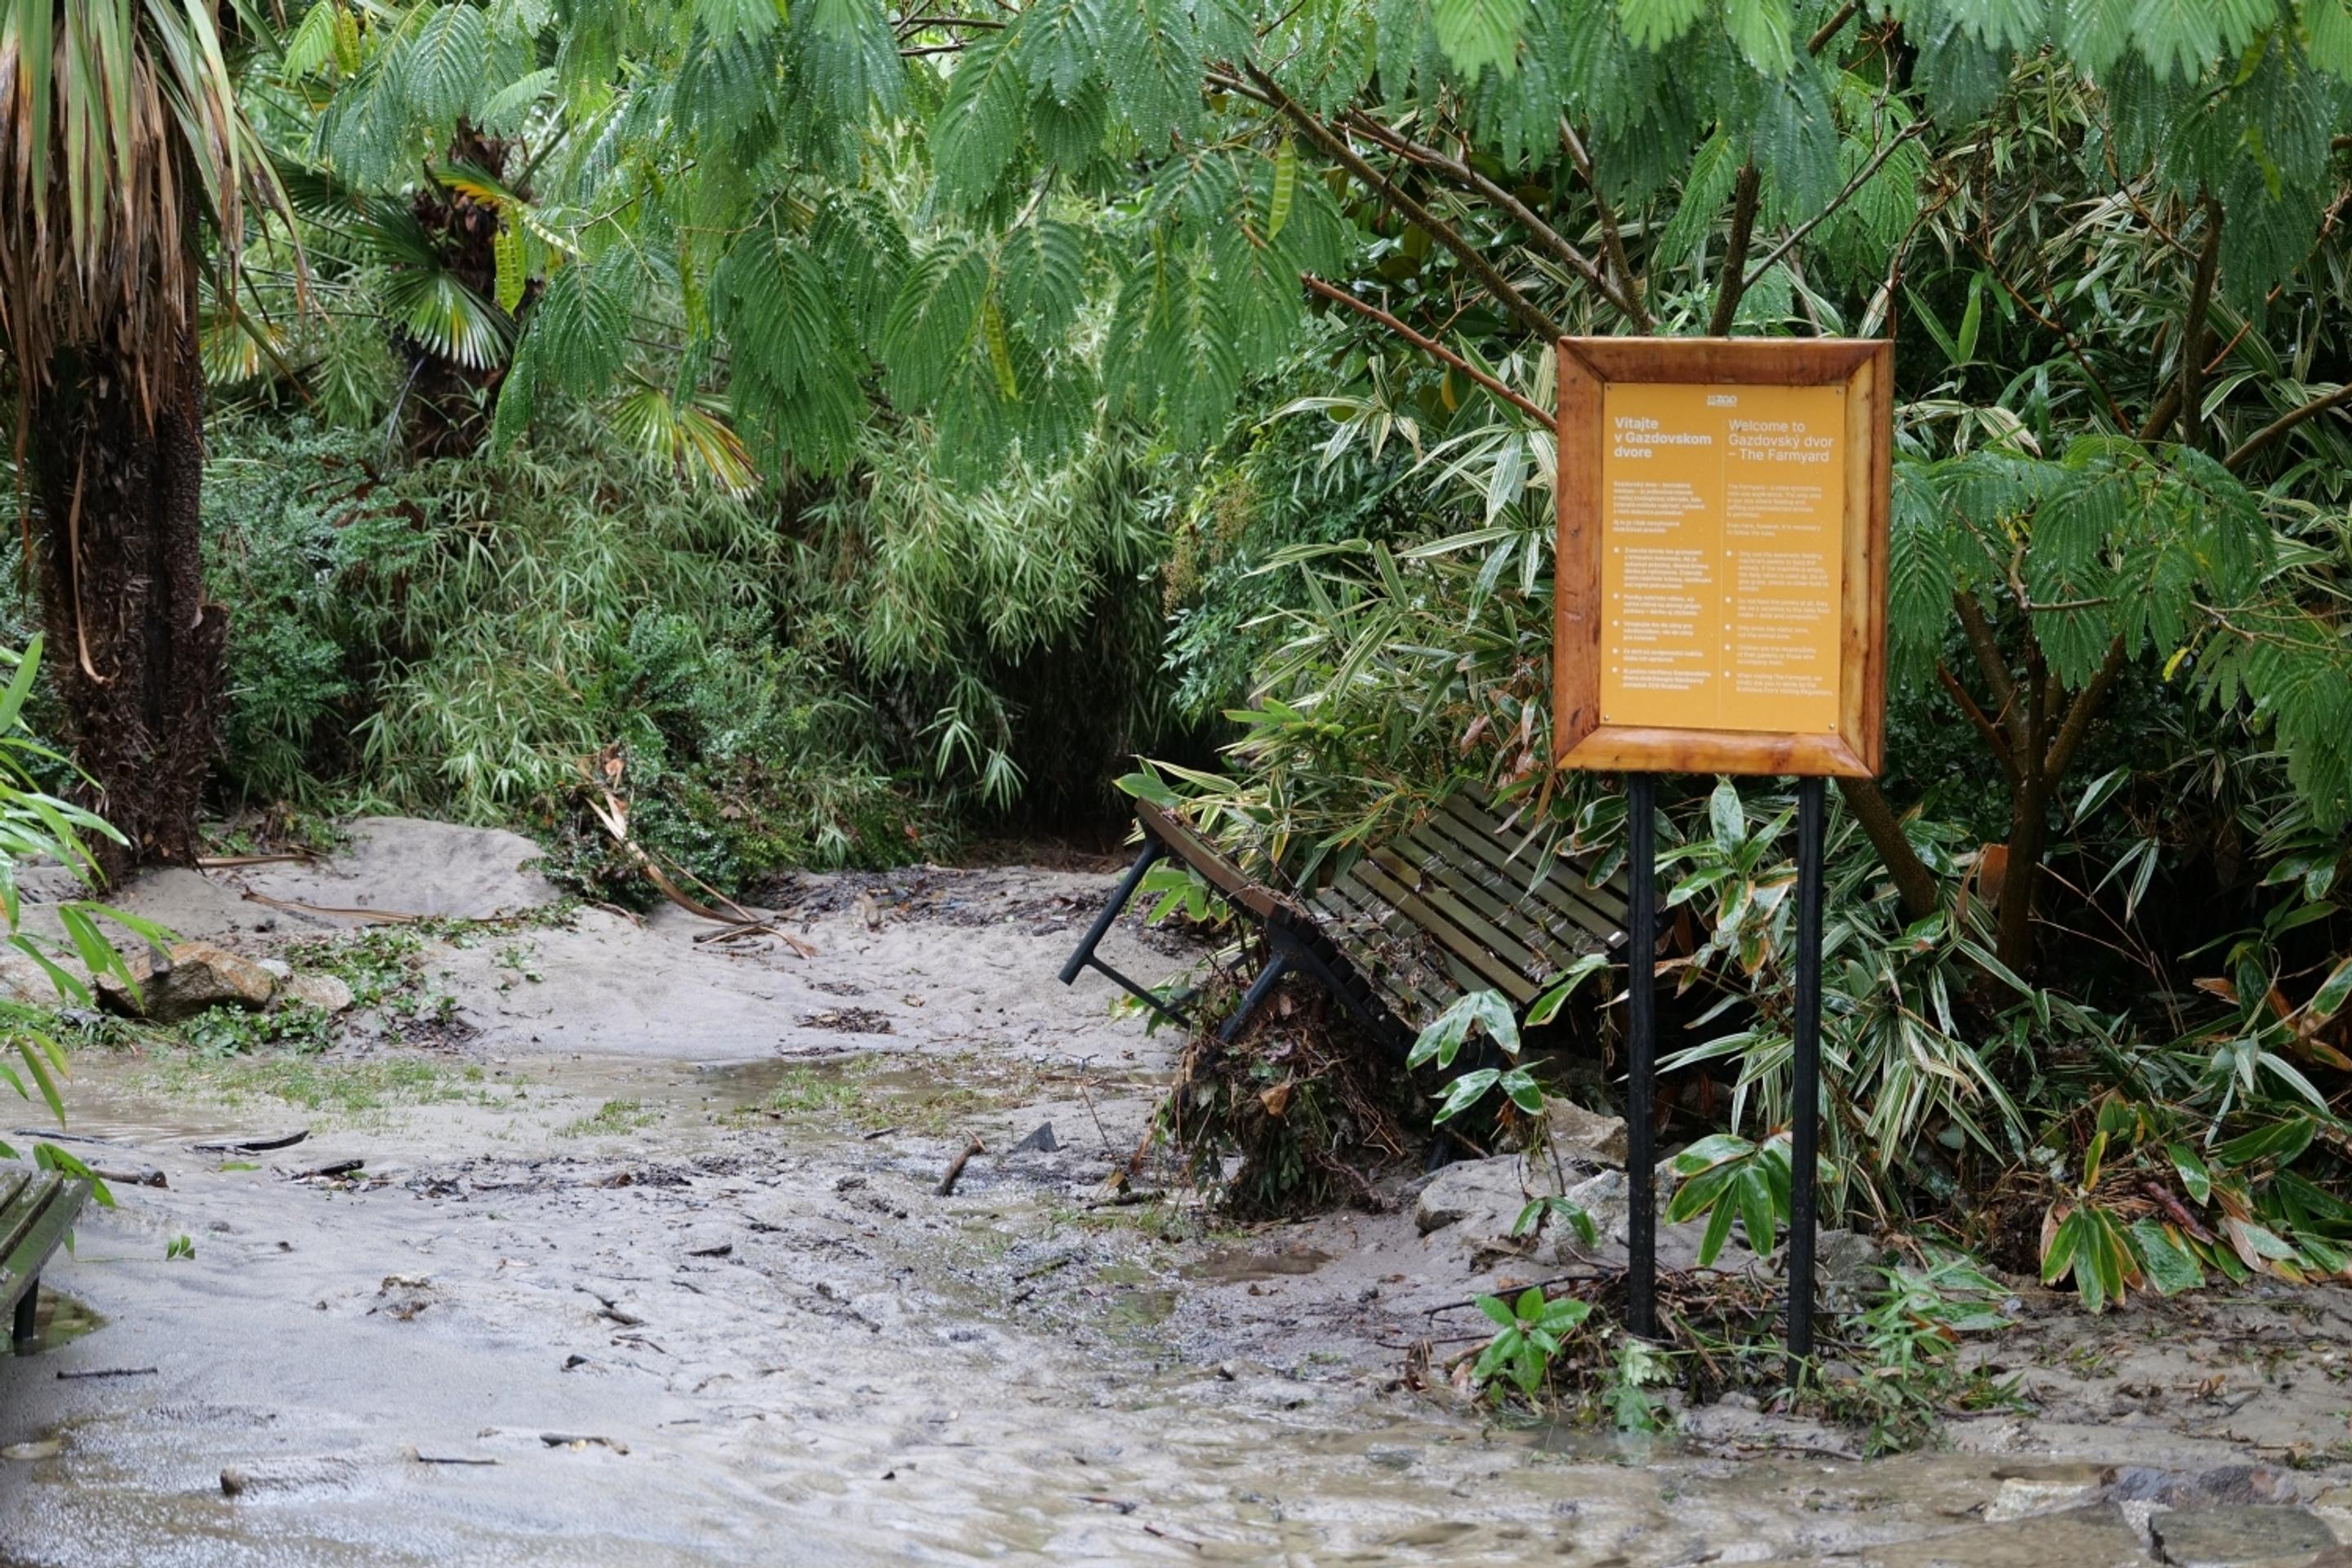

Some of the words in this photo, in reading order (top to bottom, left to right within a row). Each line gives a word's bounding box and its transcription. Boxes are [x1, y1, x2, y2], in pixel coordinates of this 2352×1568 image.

[1615, 416, 1659, 431] Vitajte
[1729, 419, 1788, 432] Welcome
[1793, 421, 1806, 432] to
[1615, 433, 1622, 443] v
[1626, 432, 1712, 445] Gazdovskom
[1729, 434, 1800, 449] Gazdovský
[1804, 436, 1834, 447] dvor
[1614, 446, 1652, 457] dvore
[1740, 448, 1763, 460] The
[1768, 449, 1829, 464] Farmyard
